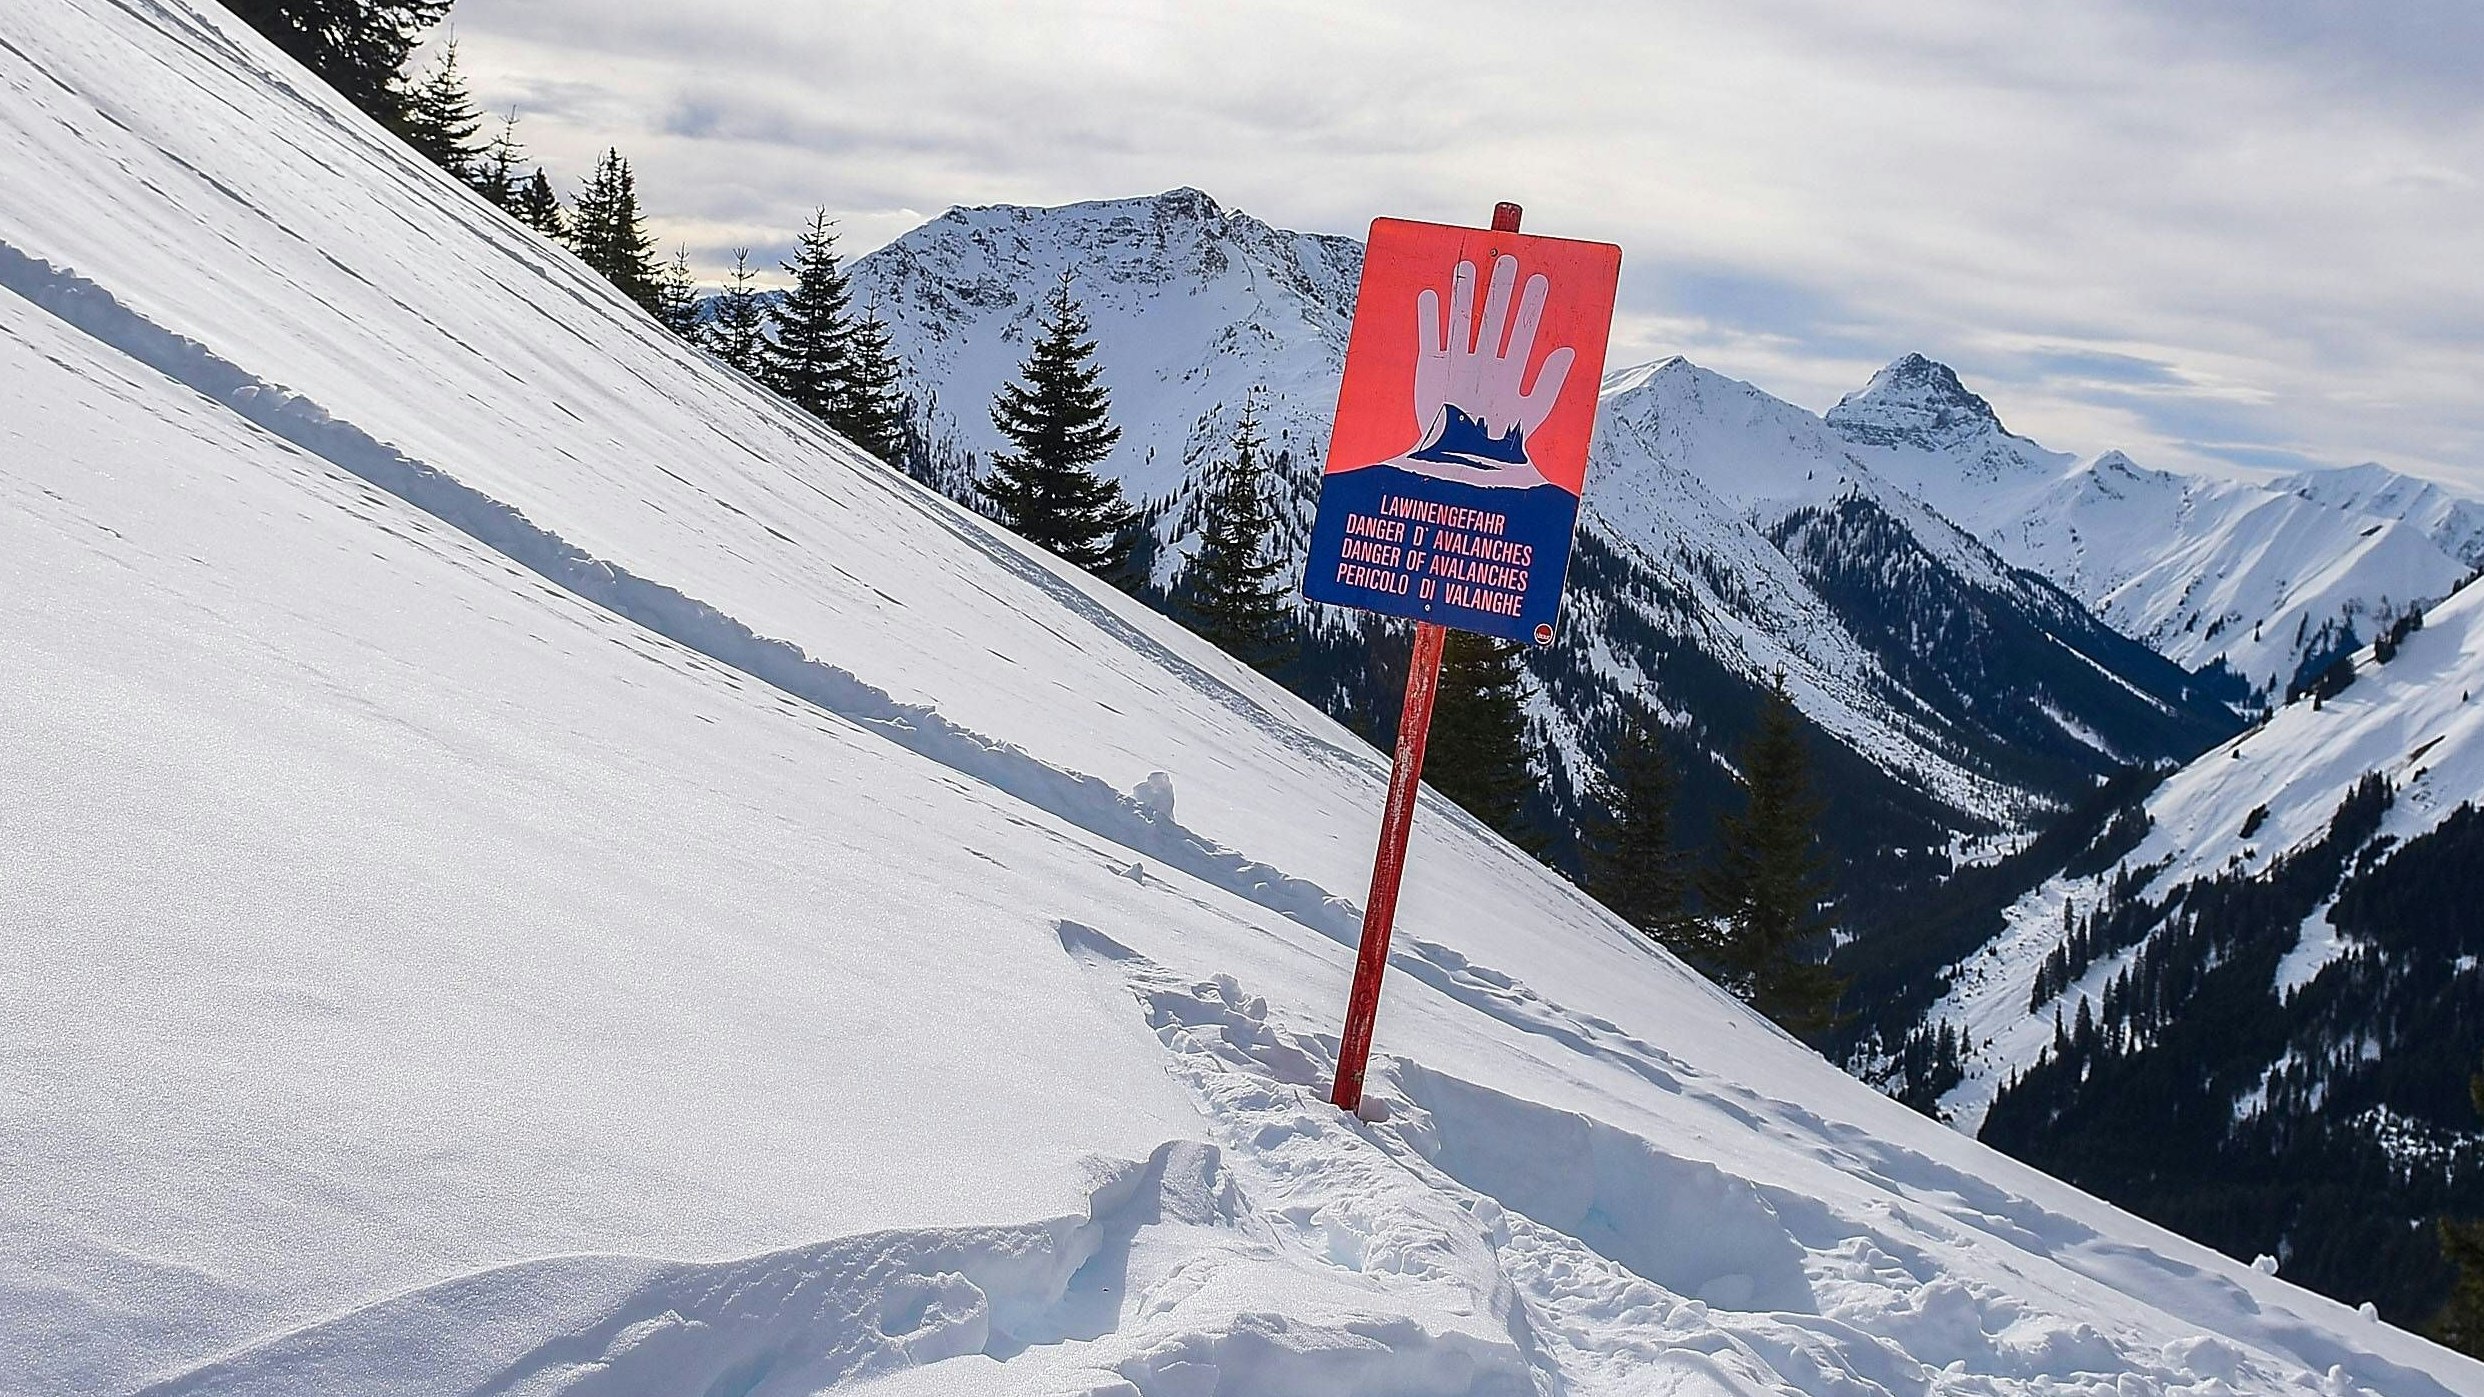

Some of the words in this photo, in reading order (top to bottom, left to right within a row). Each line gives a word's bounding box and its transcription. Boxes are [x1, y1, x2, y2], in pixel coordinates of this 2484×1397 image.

[1345, 513, 1406, 543] DANGER
[1432, 529, 1533, 567] AVALANCHES
[1380, 494, 1506, 536] LAWINENGEFAHR
[1336, 562, 1409, 595] PERICOLO
[1419, 578, 1436, 601] DI
[1445, 582, 1524, 617] VALANGHE
[1341, 537, 1401, 568] DANGER
[1406, 549, 1427, 572] OF
[1428, 554, 1529, 592] AVALANCHES
